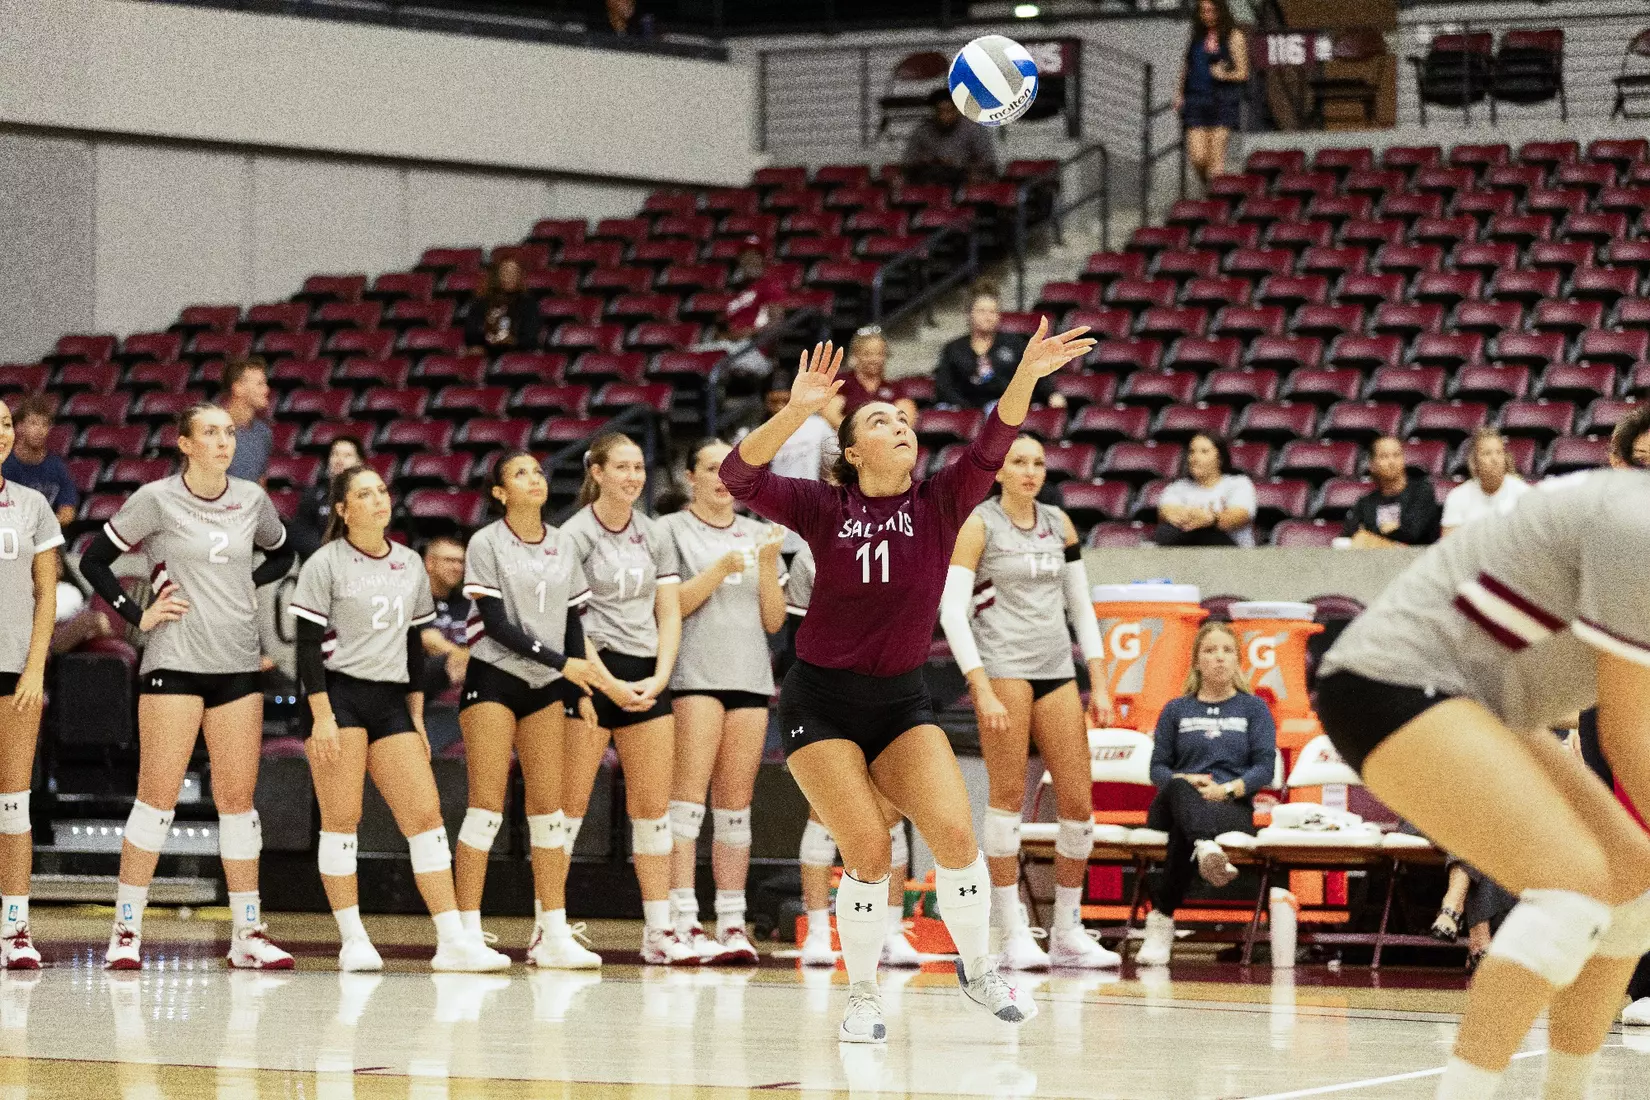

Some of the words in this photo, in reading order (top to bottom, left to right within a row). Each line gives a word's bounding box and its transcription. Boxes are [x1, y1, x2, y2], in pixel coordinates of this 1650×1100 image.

[1267, 34, 1306, 65] 116
[989, 88, 1031, 120] molten
[208, 531, 230, 564] 2
[855, 540, 890, 583] 11
[1024, 553, 1060, 579] 14
[535, 580, 546, 613] 1
[613, 568, 644, 598] 17
[371, 595, 405, 630] 21
[1109, 622, 1141, 660] G
[1248, 636, 1276, 668] G
